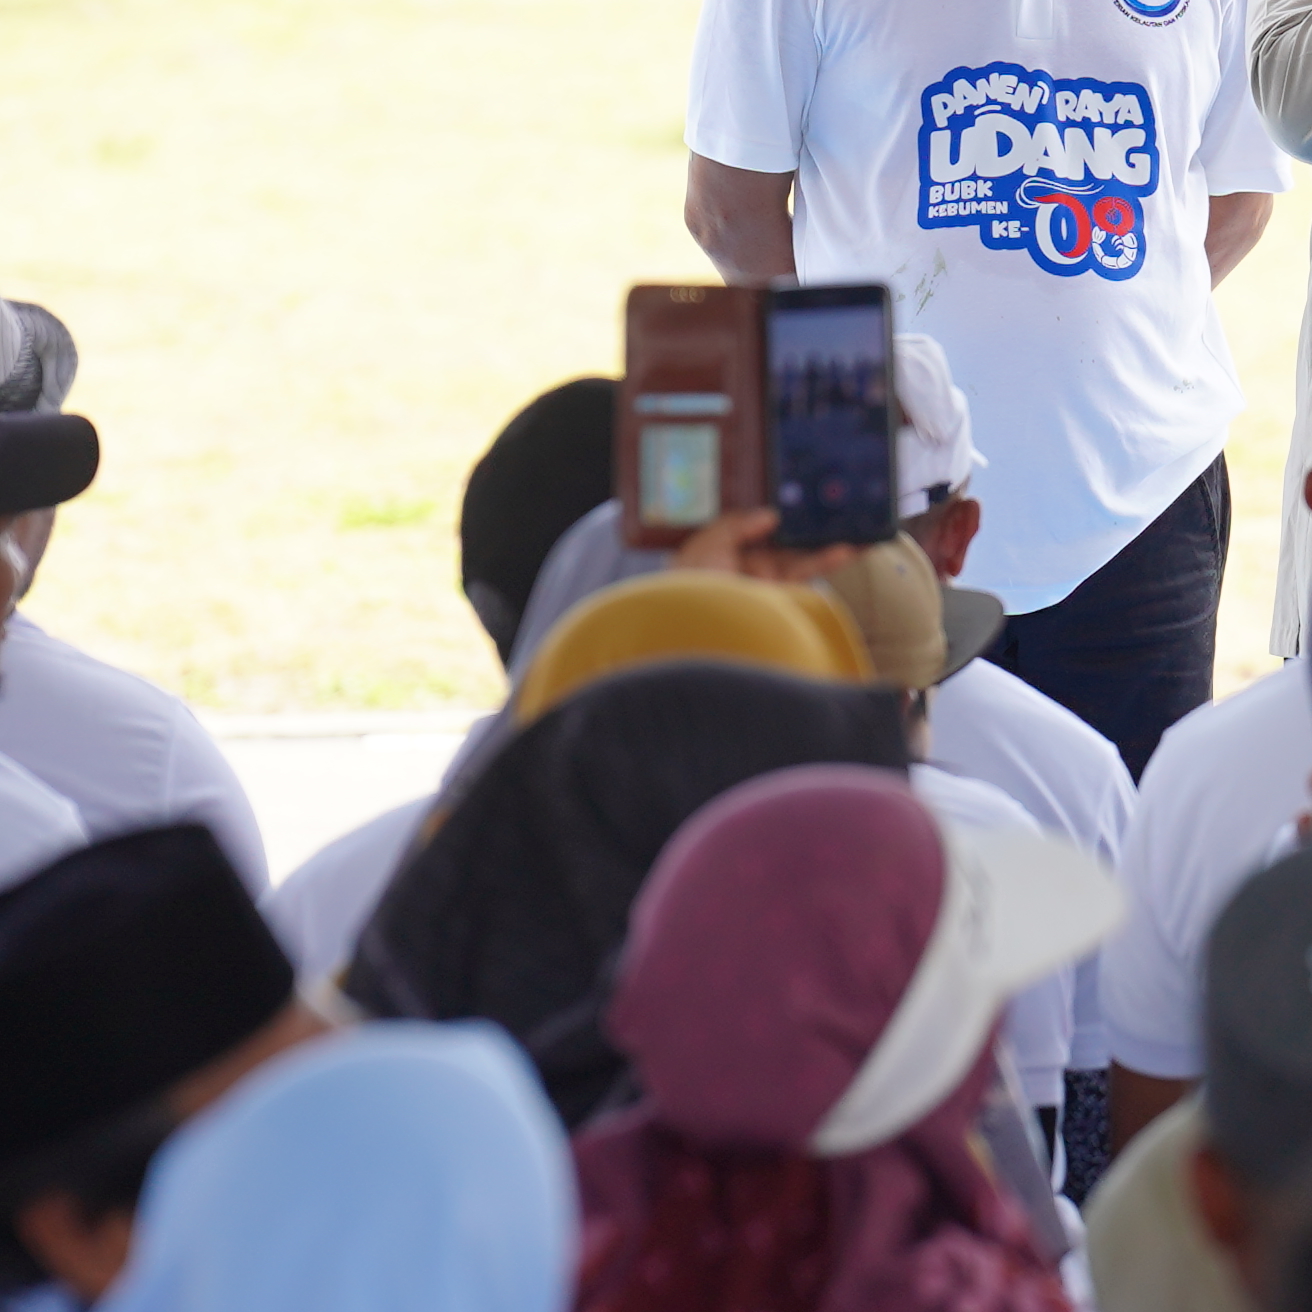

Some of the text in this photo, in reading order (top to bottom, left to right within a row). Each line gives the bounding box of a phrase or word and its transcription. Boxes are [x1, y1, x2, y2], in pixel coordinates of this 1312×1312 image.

[930, 72, 1144, 128] PANEN RAYA
[929, 112, 1151, 186] UDANG
[928, 200, 1008, 218] KEBUMEN
[929, 179, 993, 204] BUBK
